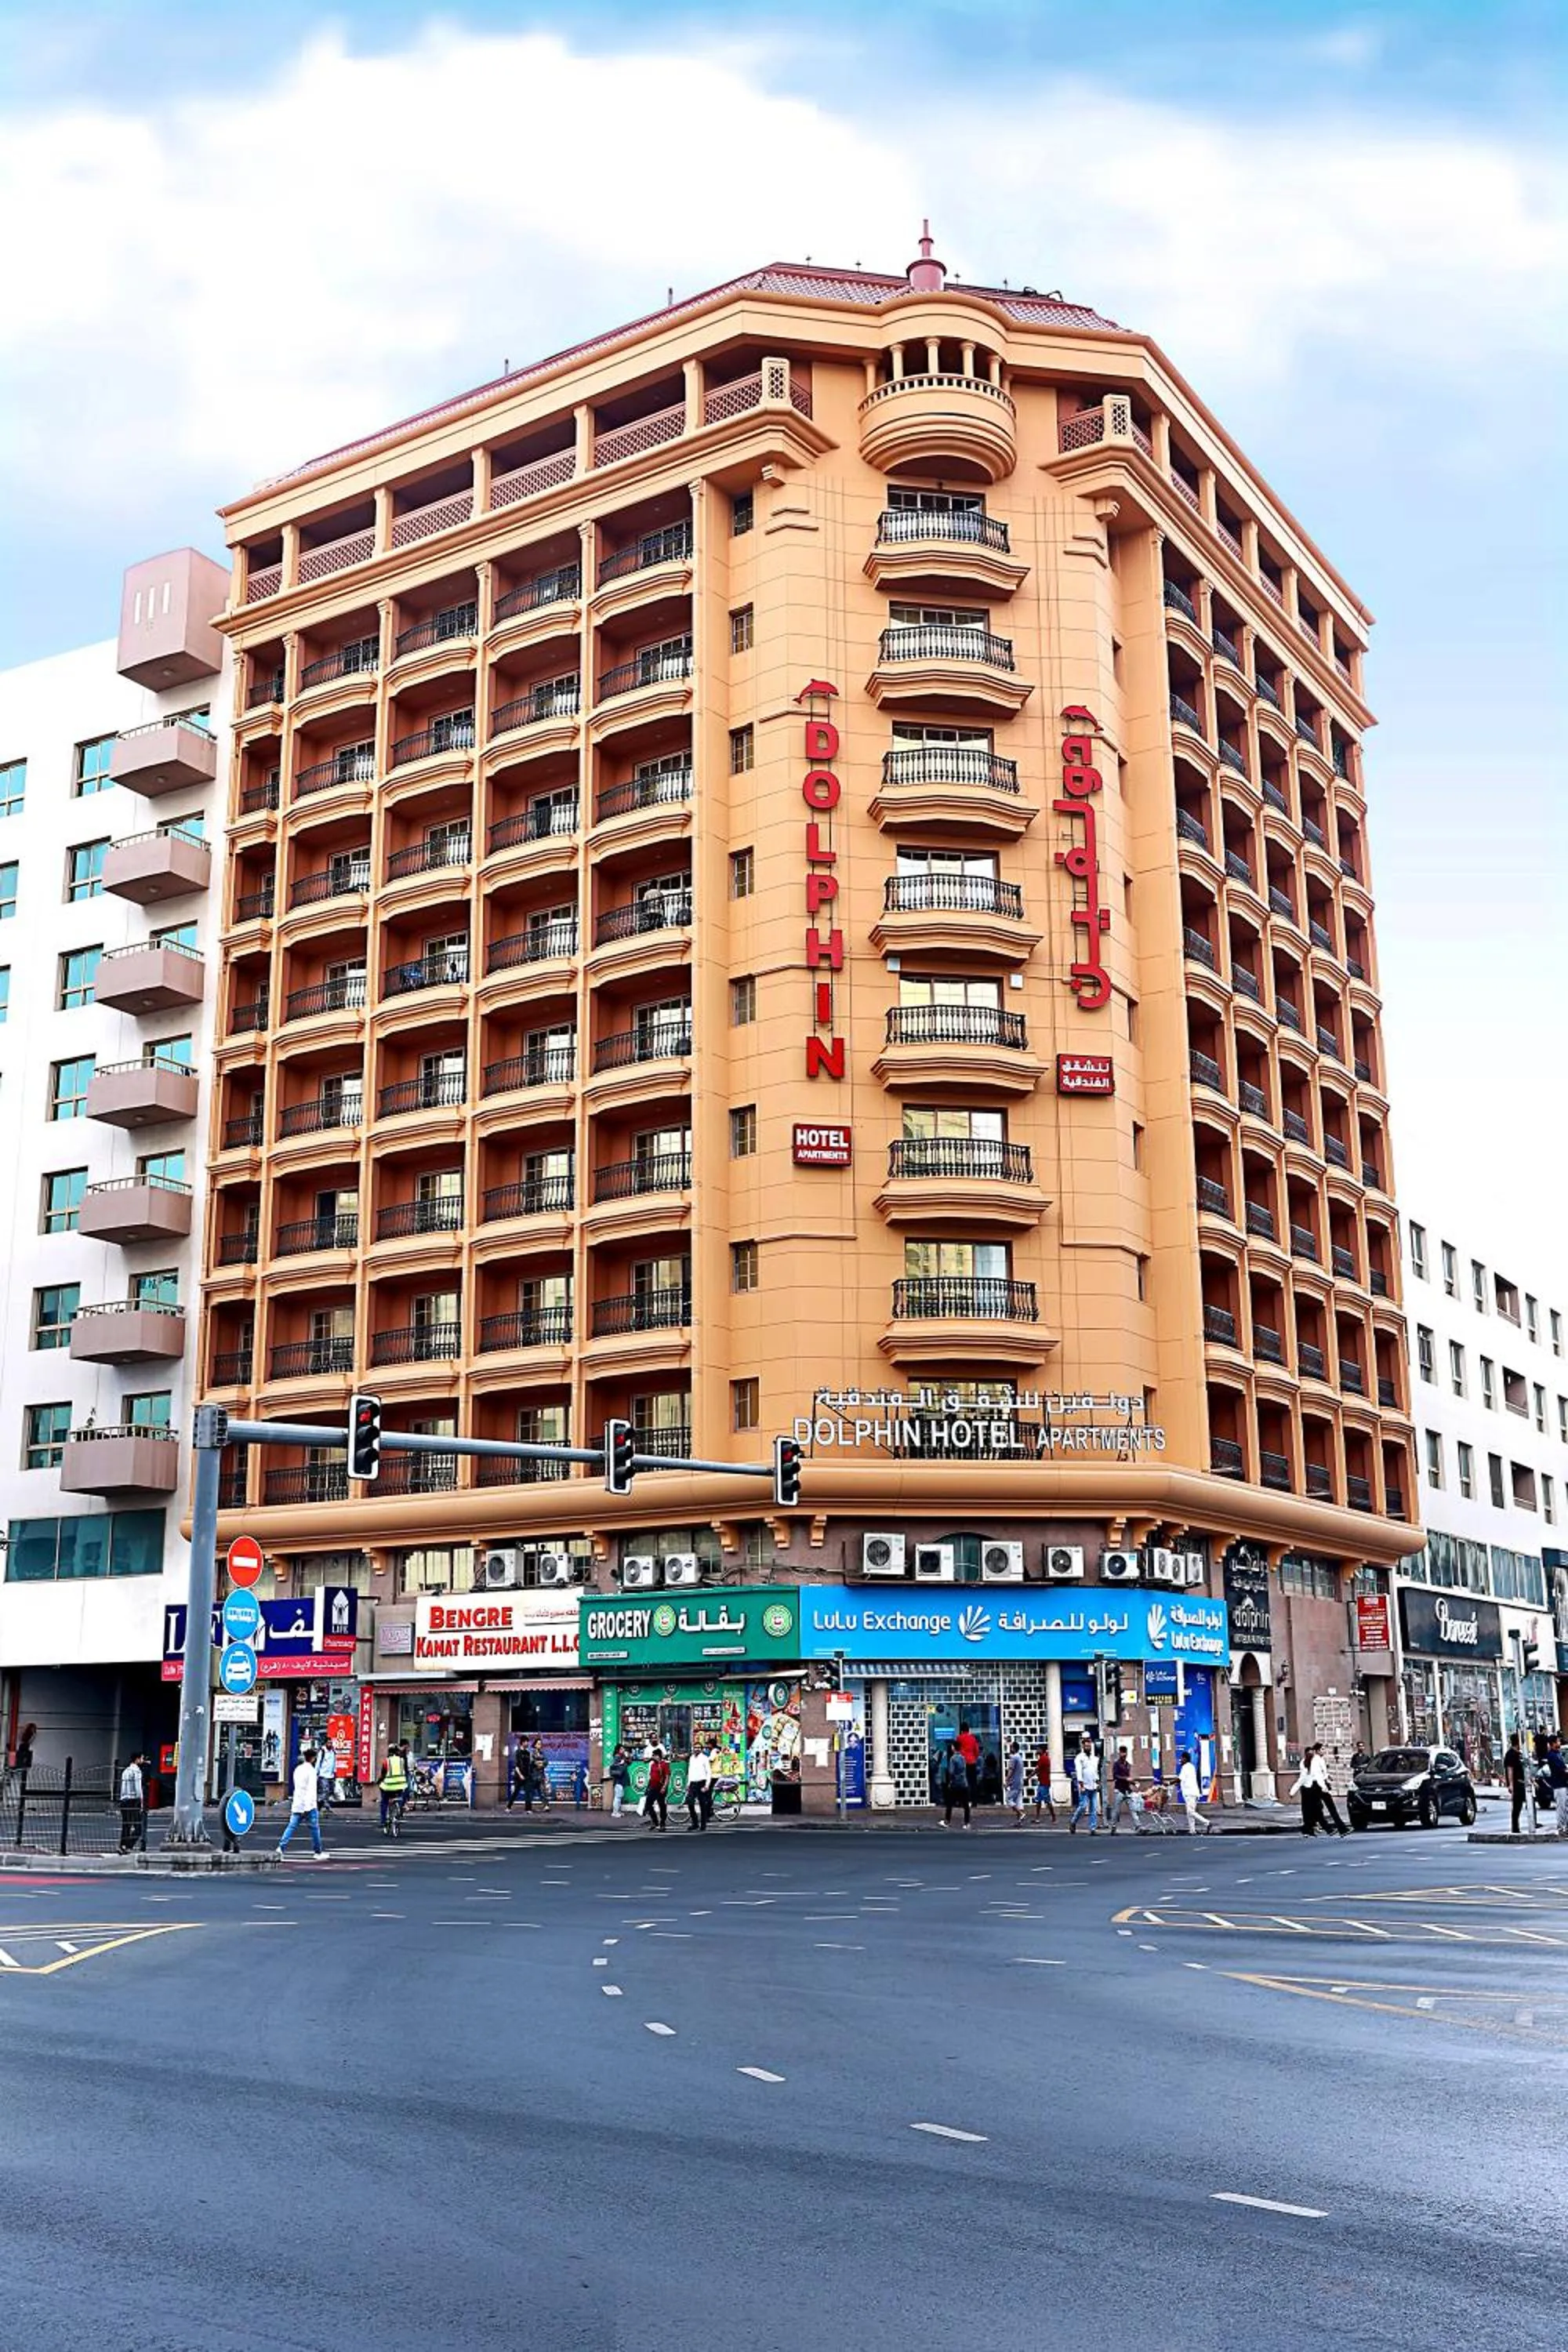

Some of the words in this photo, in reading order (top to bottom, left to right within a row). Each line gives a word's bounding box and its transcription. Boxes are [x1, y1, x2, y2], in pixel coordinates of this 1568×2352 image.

[1052, 735, 1112, 1010] دولفين
[803, 720, 846, 1080] DOLPHIN
[1062, 1059, 1109, 1073] للشقق
[1062, 1075, 1109, 1088] الفندقية
[796, 1128, 848, 1147] HOTEL
[797, 1149, 848, 1160] APARTMENTS
[815, 1386, 933, 1410] الفندقية
[1046, 1390, 1145, 1415] دولفين
[793, 1417, 922, 1446] DOLPHIN
[931, 1420, 1025, 1449] HOTEL
[1036, 1426, 1167, 1450] APARTMENTS
[429, 1606, 514, 1629] BENGRE
[588, 1610, 652, 1639] GROCERY
[678, 1606, 745, 1635] بقالة
[863, 1611, 951, 1635] Exchange
[998, 1610, 1084, 1635] للصرافة
[1087, 1613, 1128, 1635] لولو
[416, 1636, 459, 1657] KAMAT
[463, 1634, 548, 1656] RESTAURANT
[1190, 1632, 1223, 1656] Exchange
